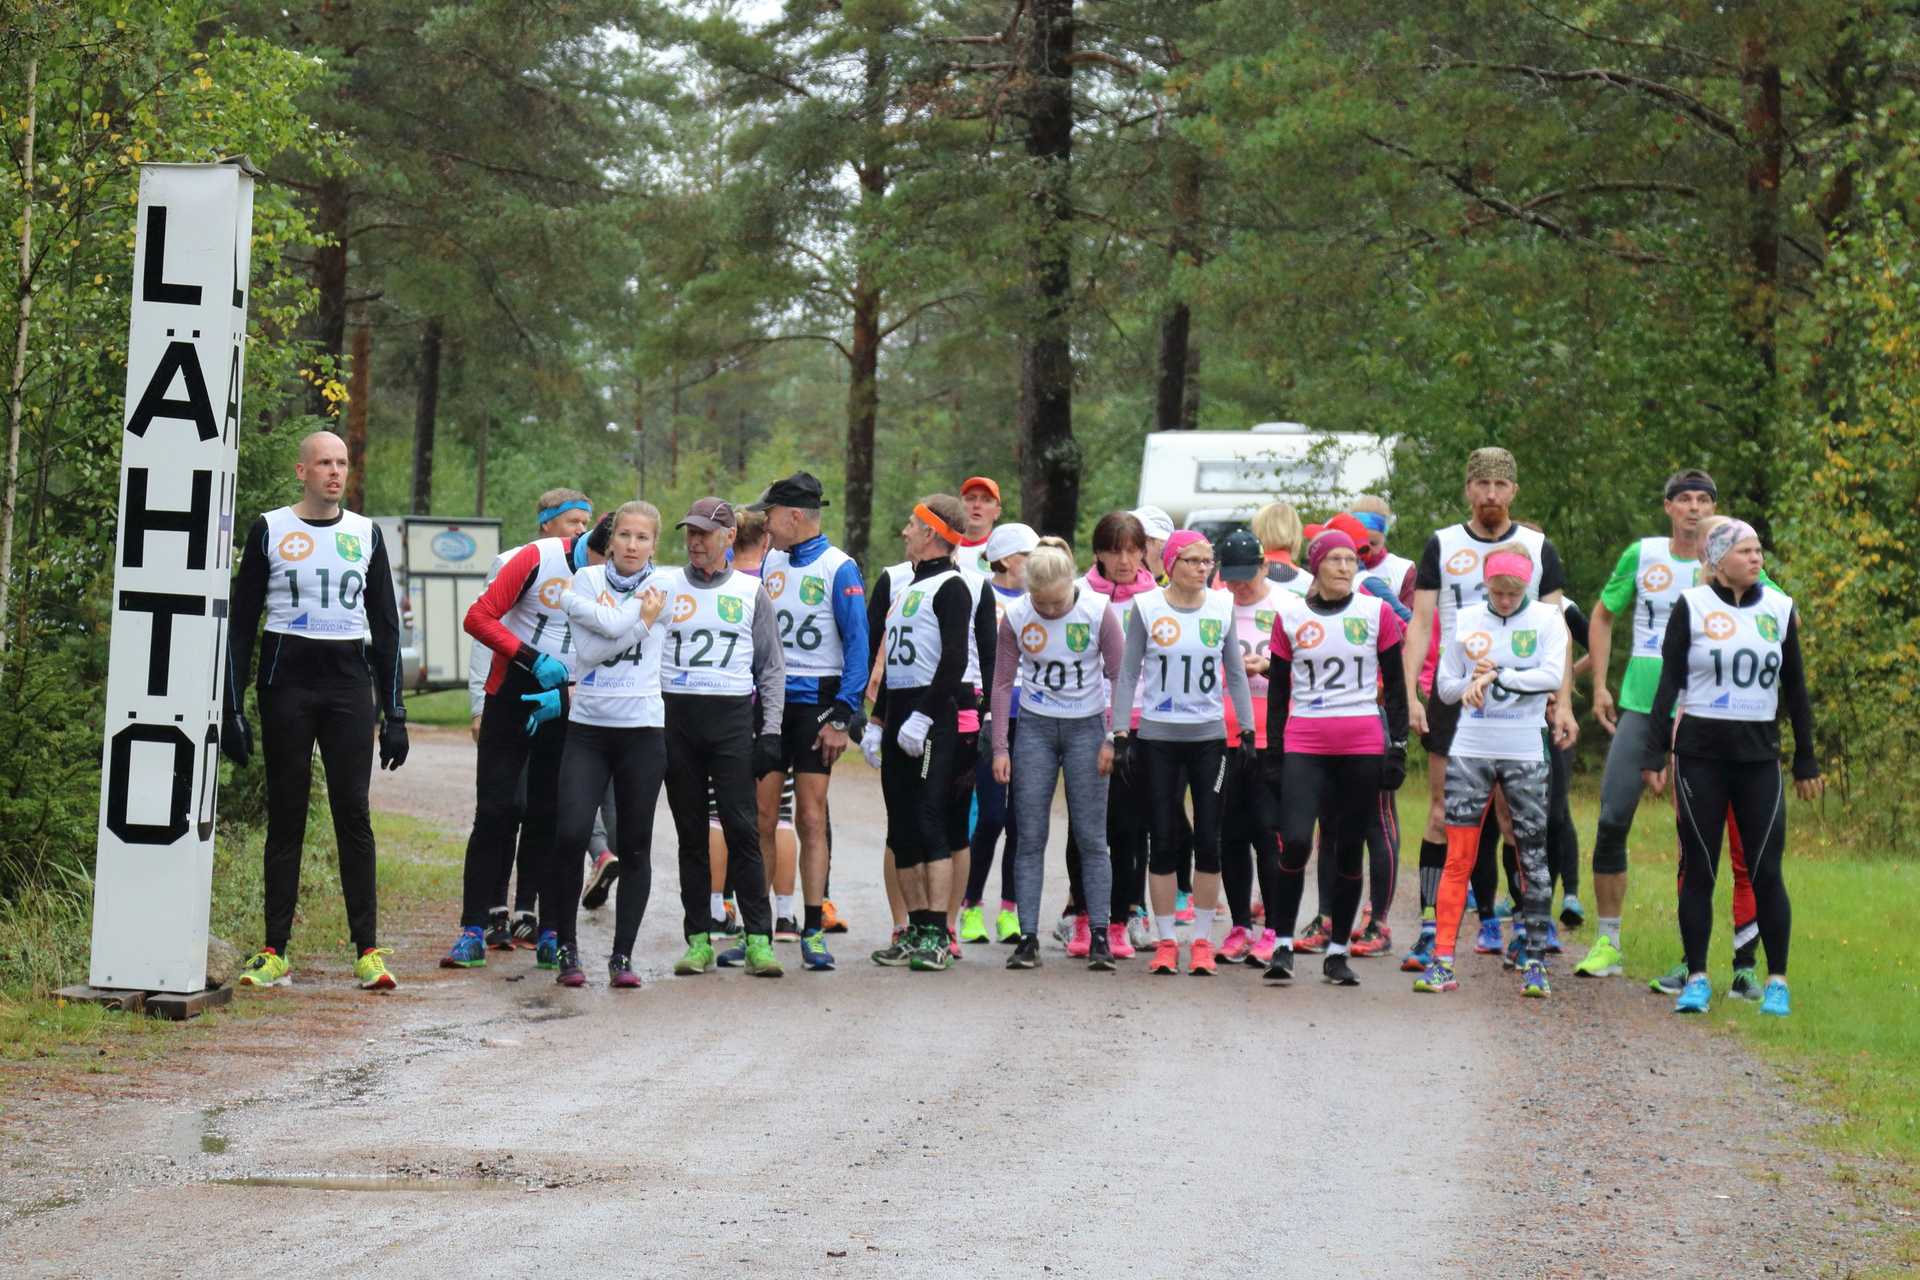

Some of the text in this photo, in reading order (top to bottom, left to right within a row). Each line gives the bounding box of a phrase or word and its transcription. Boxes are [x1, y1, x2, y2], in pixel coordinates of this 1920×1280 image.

[106, 205, 219, 846] LÄHTÖ
[284, 568, 363, 610] 110
[671, 629, 739, 668] 127
[887, 625, 916, 666] 25
[1031, 660, 1083, 692] 101
[1158, 655, 1216, 694] 118
[1304, 656, 1364, 690] 121
[1709, 647, 1780, 689] 108
